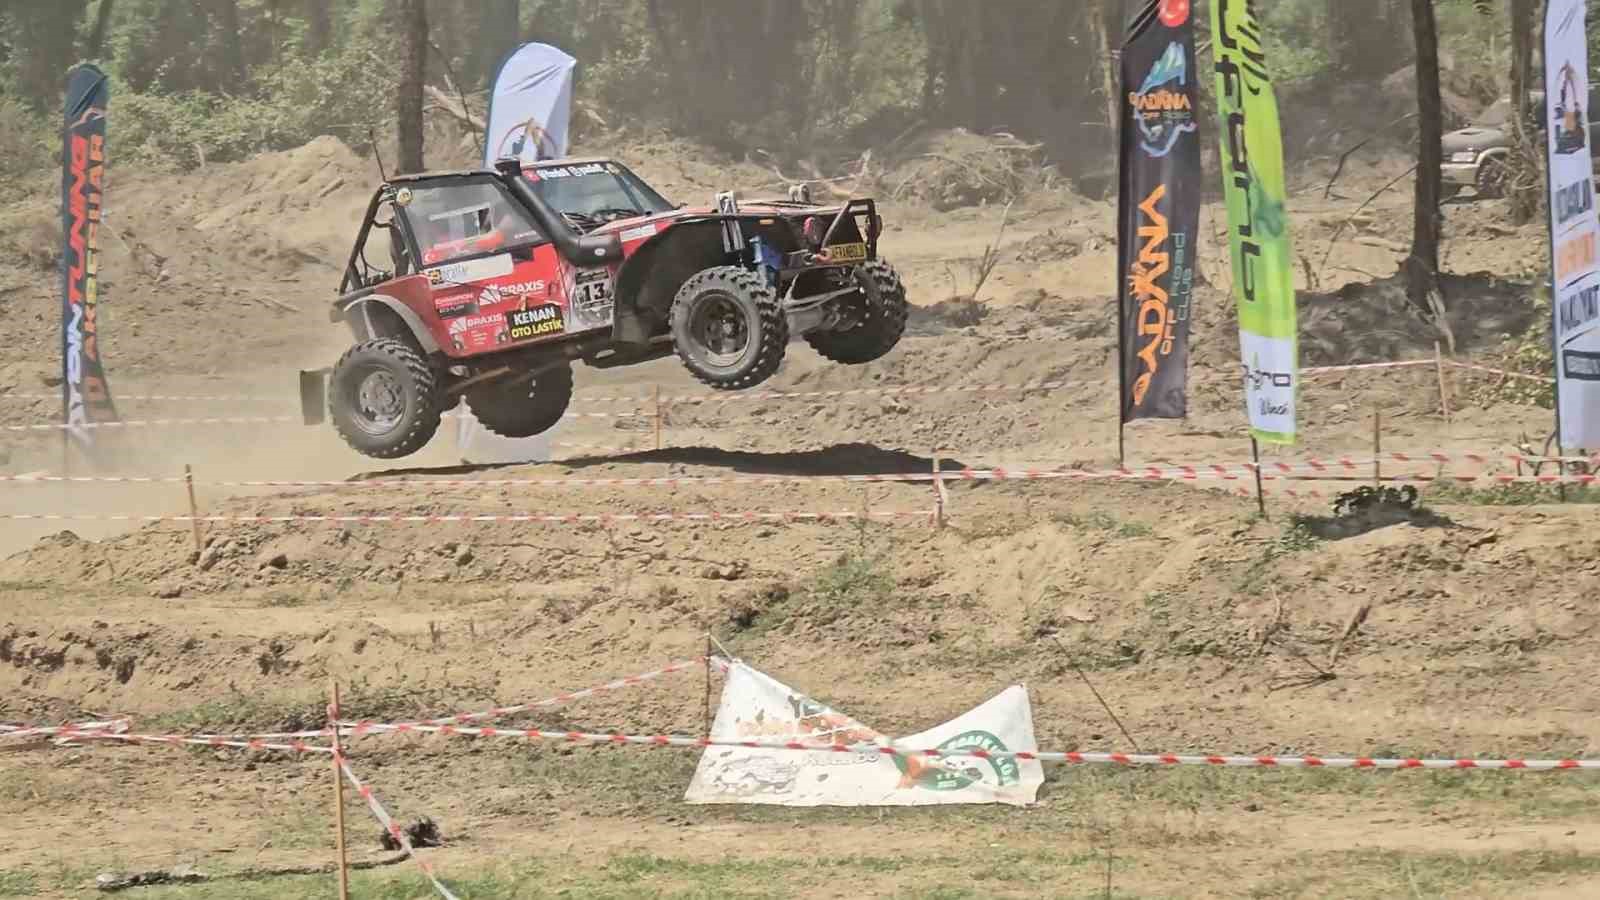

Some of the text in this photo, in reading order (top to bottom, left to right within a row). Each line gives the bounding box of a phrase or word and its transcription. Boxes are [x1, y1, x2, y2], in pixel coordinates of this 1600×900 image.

[583, 282, 605, 302] 13
[1129, 183, 1169, 377] ADANA
[1177, 267, 1192, 322] CLUB
[511, 325, 532, 338] OTO
[513, 306, 556, 326] KENAN
[1159, 308, 1177, 356] OFF
